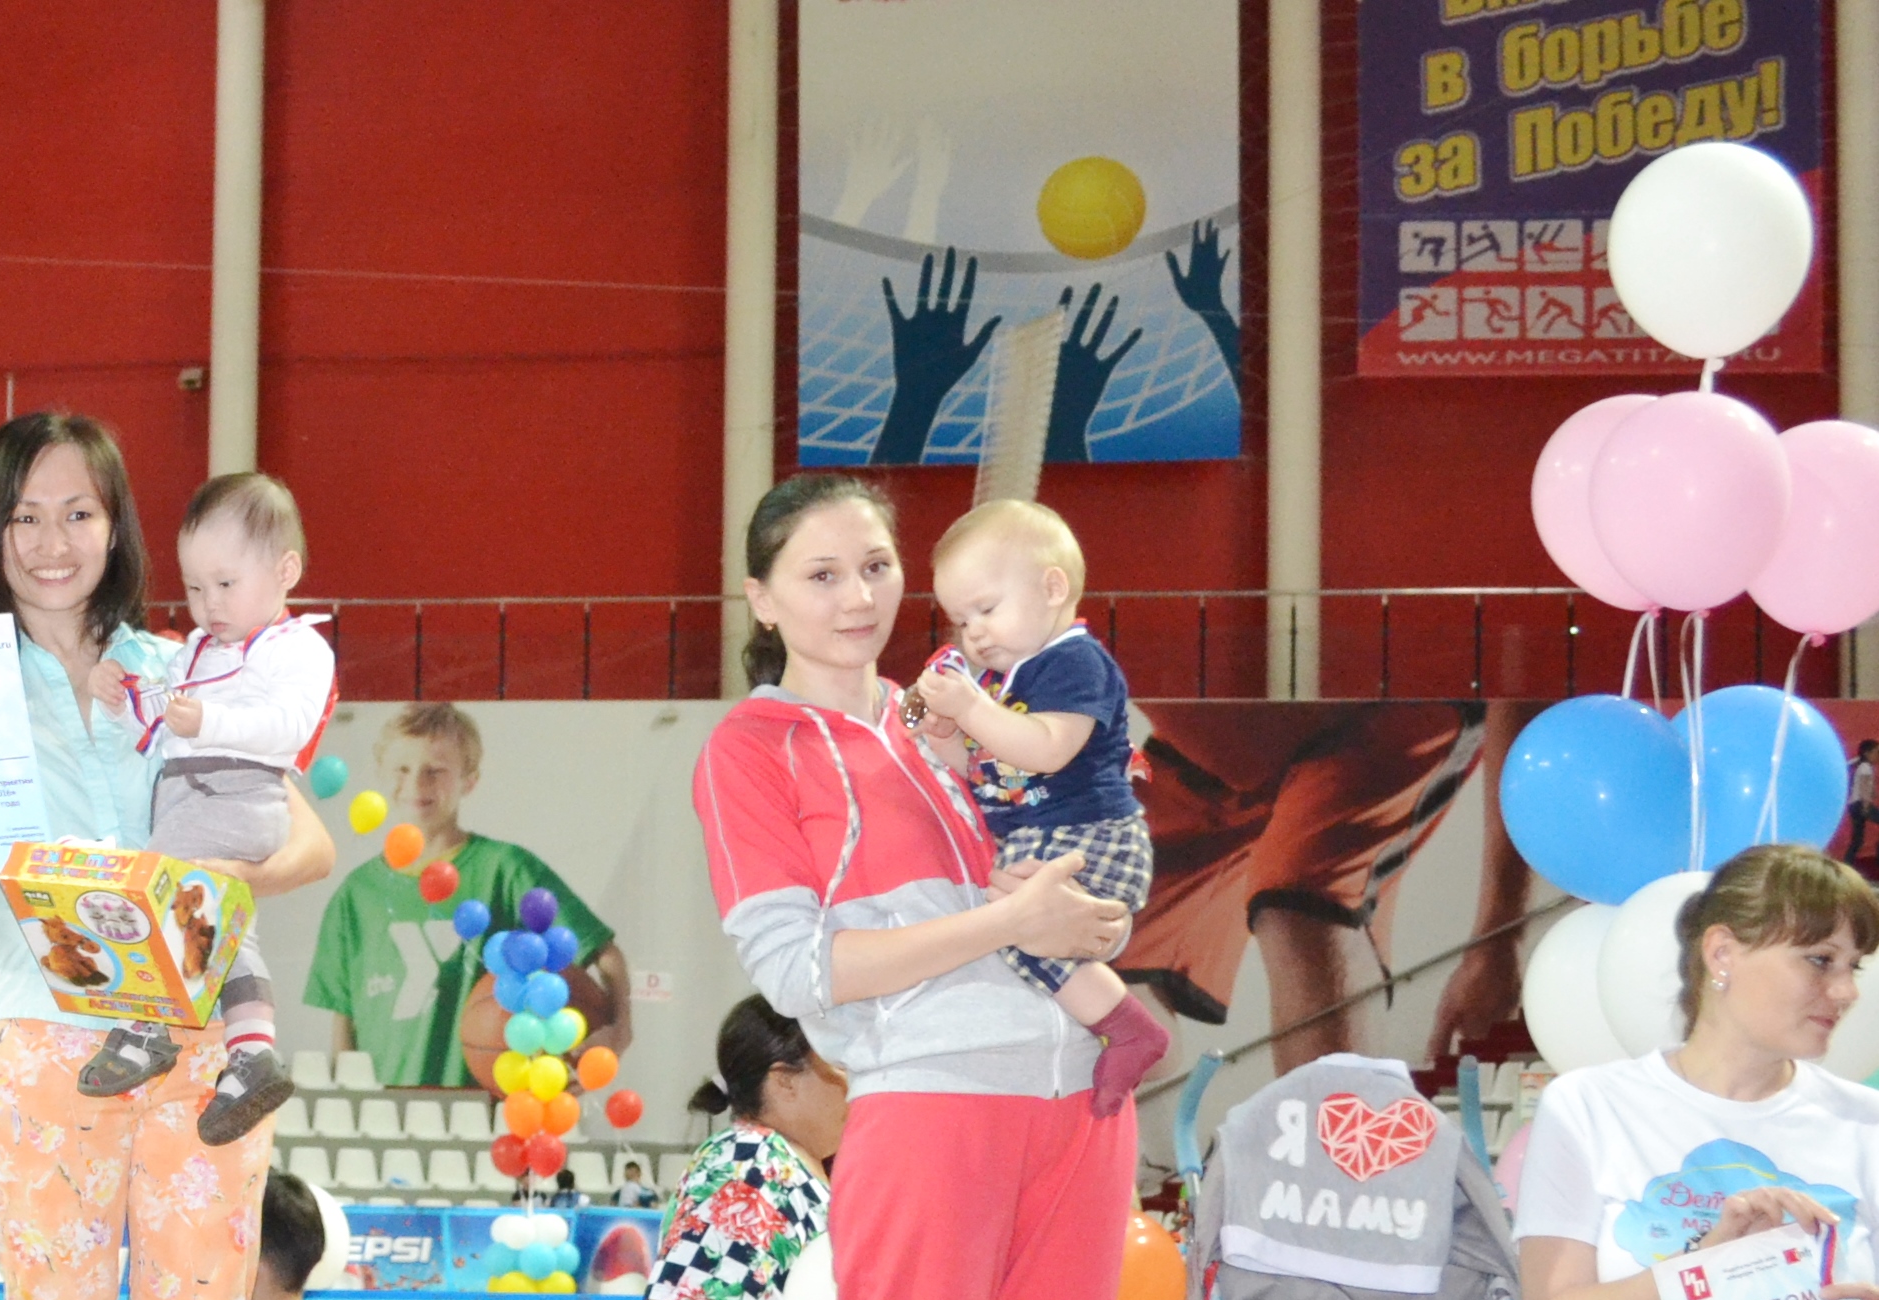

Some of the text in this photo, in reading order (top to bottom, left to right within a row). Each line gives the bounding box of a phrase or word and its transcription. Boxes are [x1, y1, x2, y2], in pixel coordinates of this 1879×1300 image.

[1499, 0, 1748, 96] борьбе
[1395, 57, 1785, 201] за Победу!
[1267, 1098, 1308, 1168] Я
[1259, 1179, 1428, 1241] МАМУ
[349, 1236, 433, 1264] EPSI
